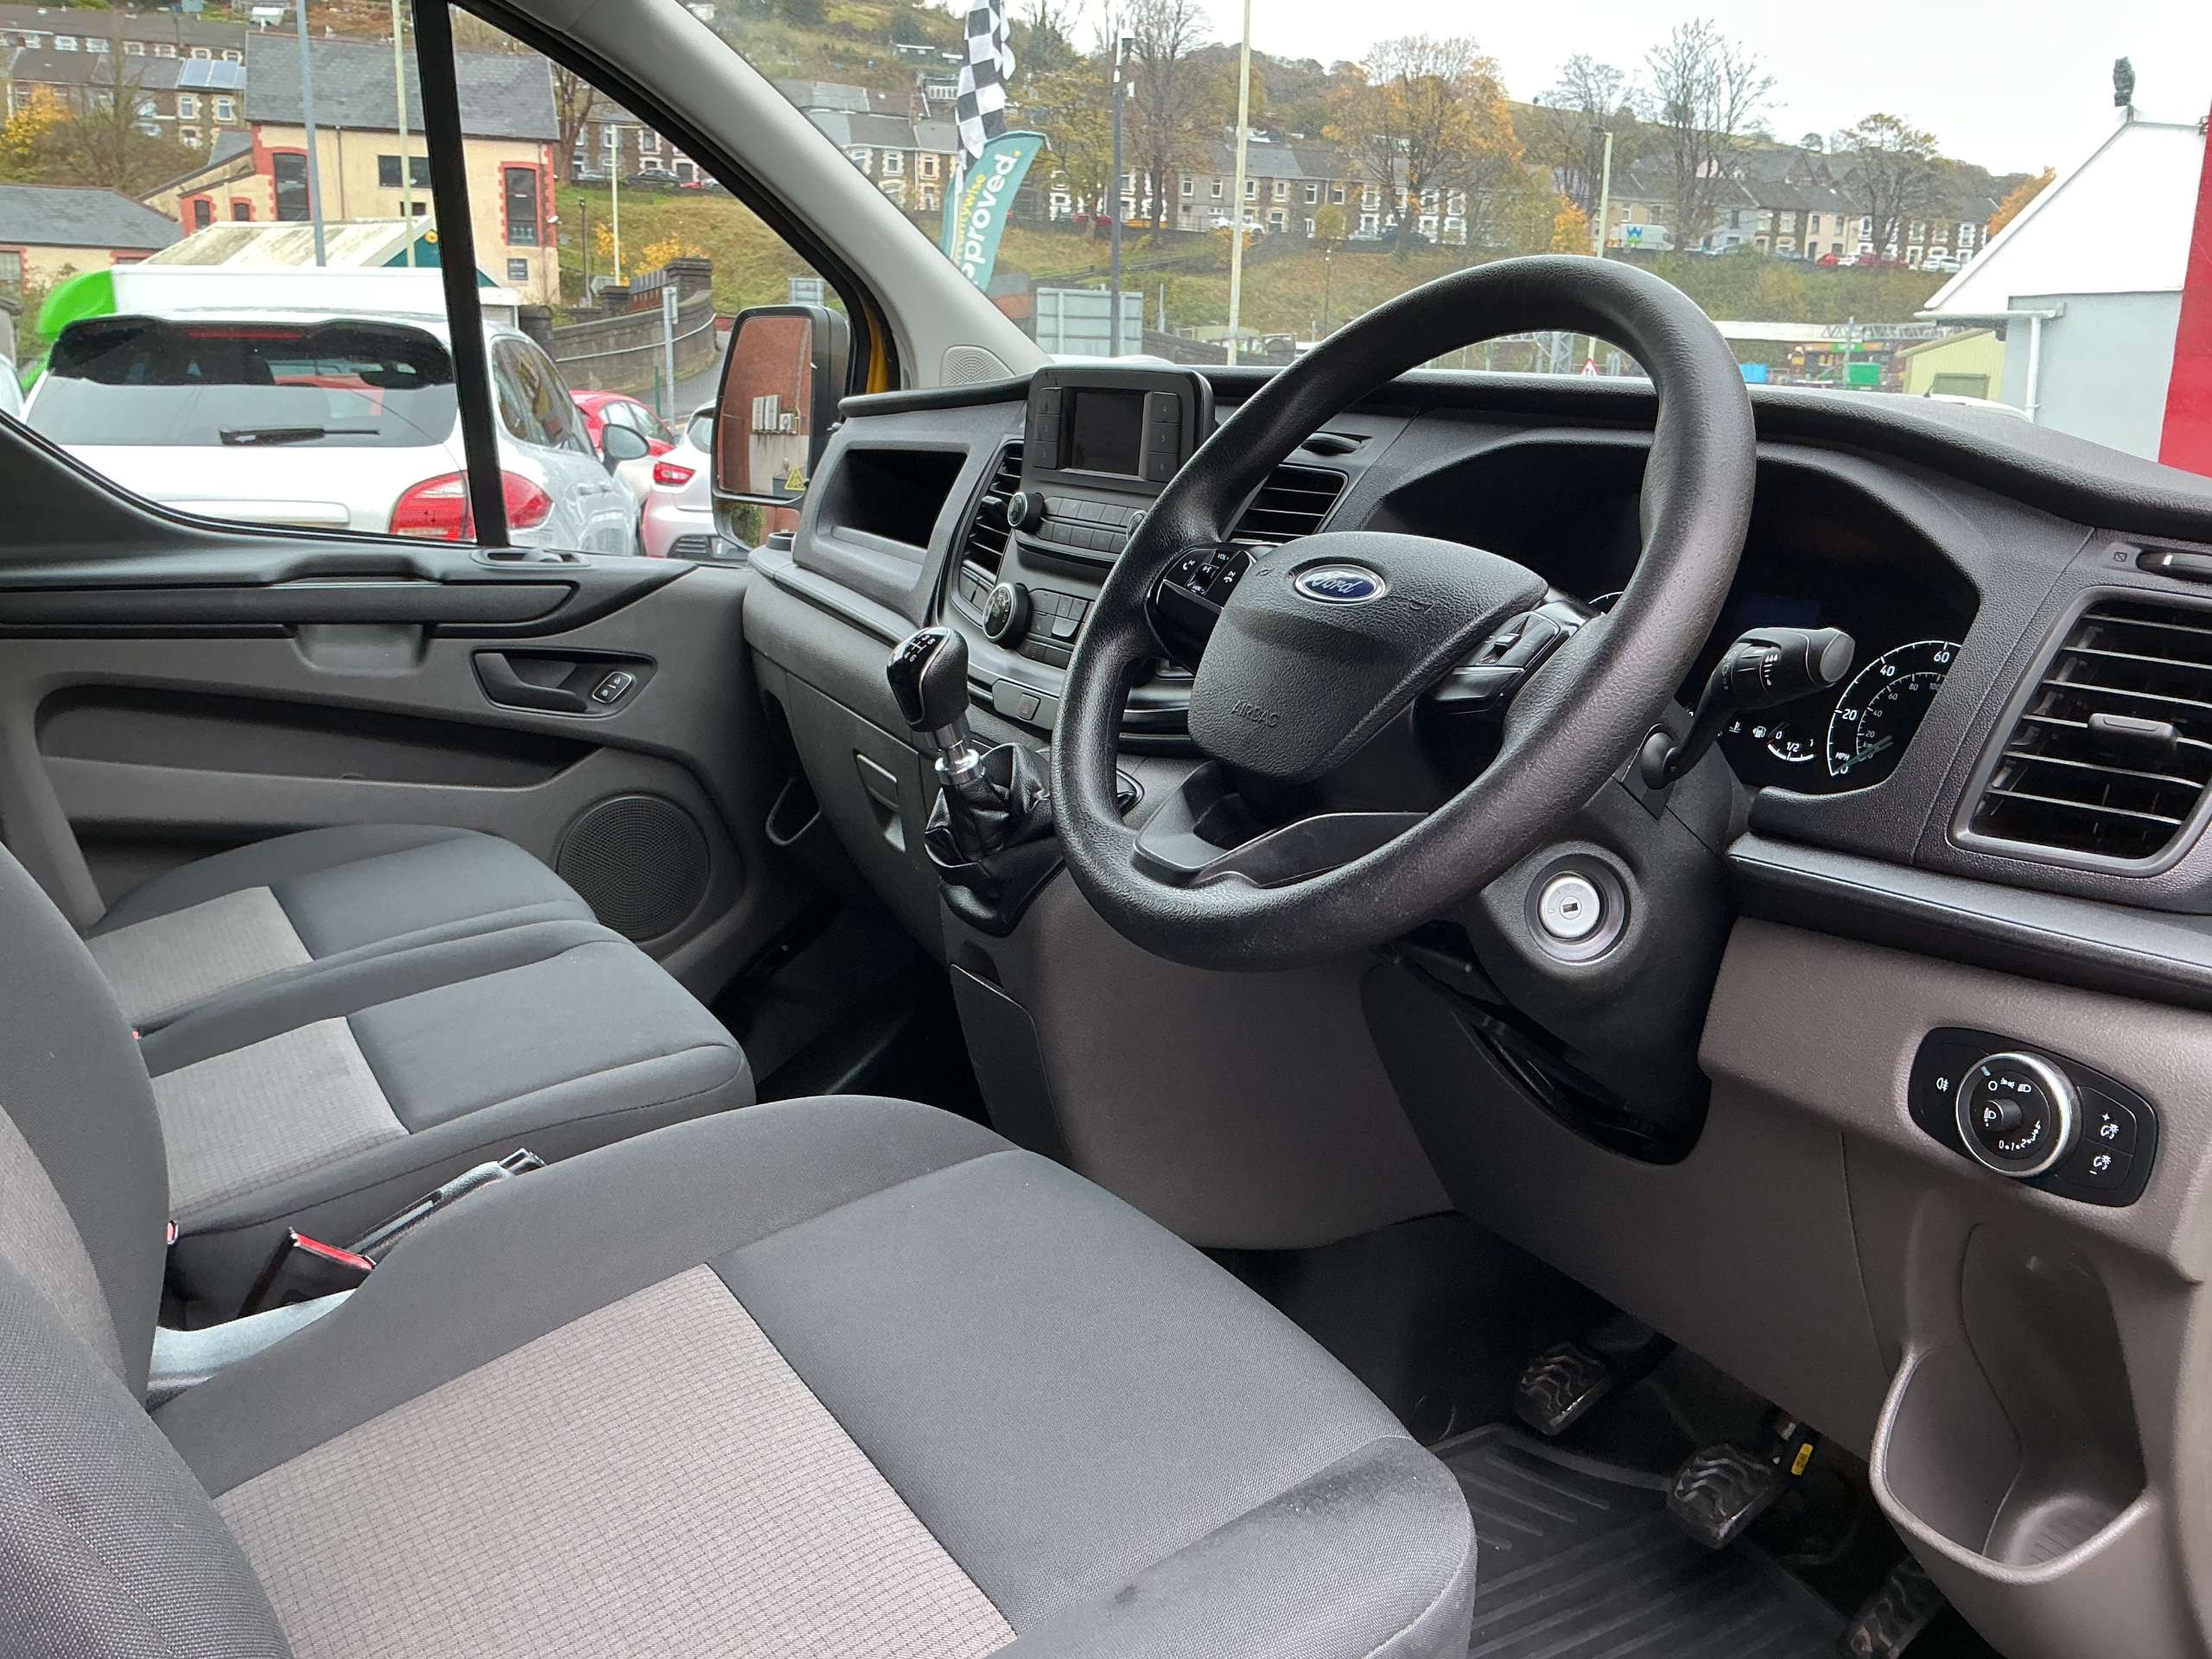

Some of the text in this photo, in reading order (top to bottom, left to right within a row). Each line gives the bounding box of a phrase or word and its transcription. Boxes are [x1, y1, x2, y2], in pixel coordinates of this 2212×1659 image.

[1310, 577, 1363, 594] Ford
[1933, 651, 1950, 664] 60
[1879, 665, 1896, 677] 40
[1908, 683, 1919, 691] 80
[1888, 692, 1898, 701] 60
[1231, 699, 1281, 728] AIRBAG
[1841, 709, 1858, 721] 20
[1872, 709, 1883, 718] 40
[1775, 730, 1783, 740] 0
[1865, 730, 1876, 739] 20
[1786, 741, 1800, 753] 1/2
[1834, 751, 1850, 761] MPH
